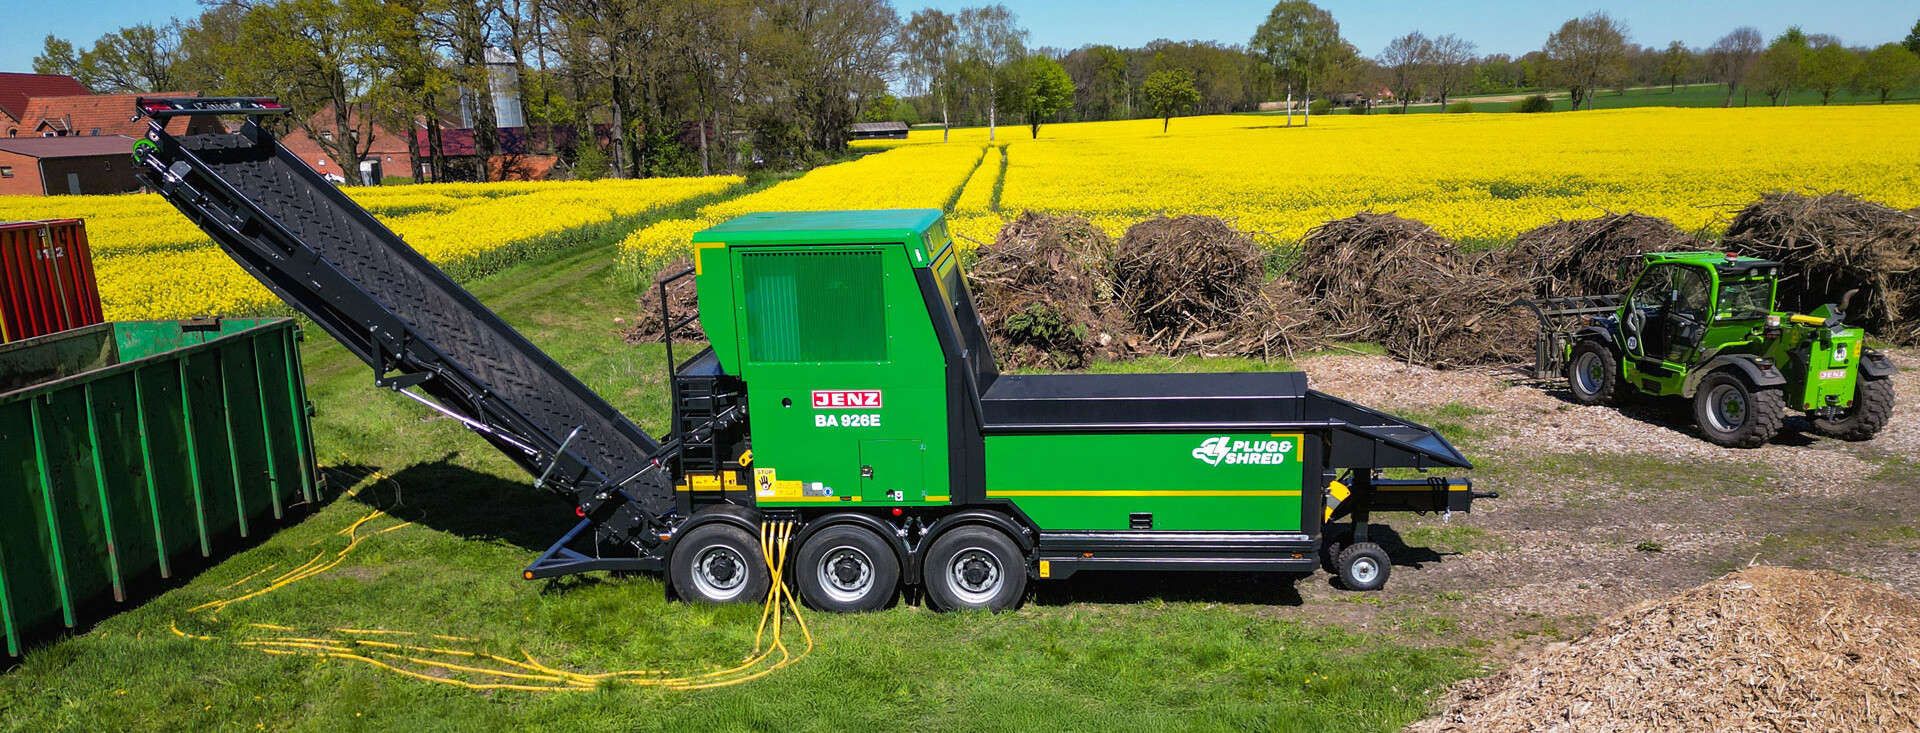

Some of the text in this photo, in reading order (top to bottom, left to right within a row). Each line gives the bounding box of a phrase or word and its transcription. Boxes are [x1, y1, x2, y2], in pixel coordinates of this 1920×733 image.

[1628, 338, 1636, 348] 20
[815, 393, 879, 406] JENZ
[815, 414, 881, 427] BA 926E
[1232, 440, 1292, 452] PLUG&
[1225, 452, 1284, 464] SHRED
